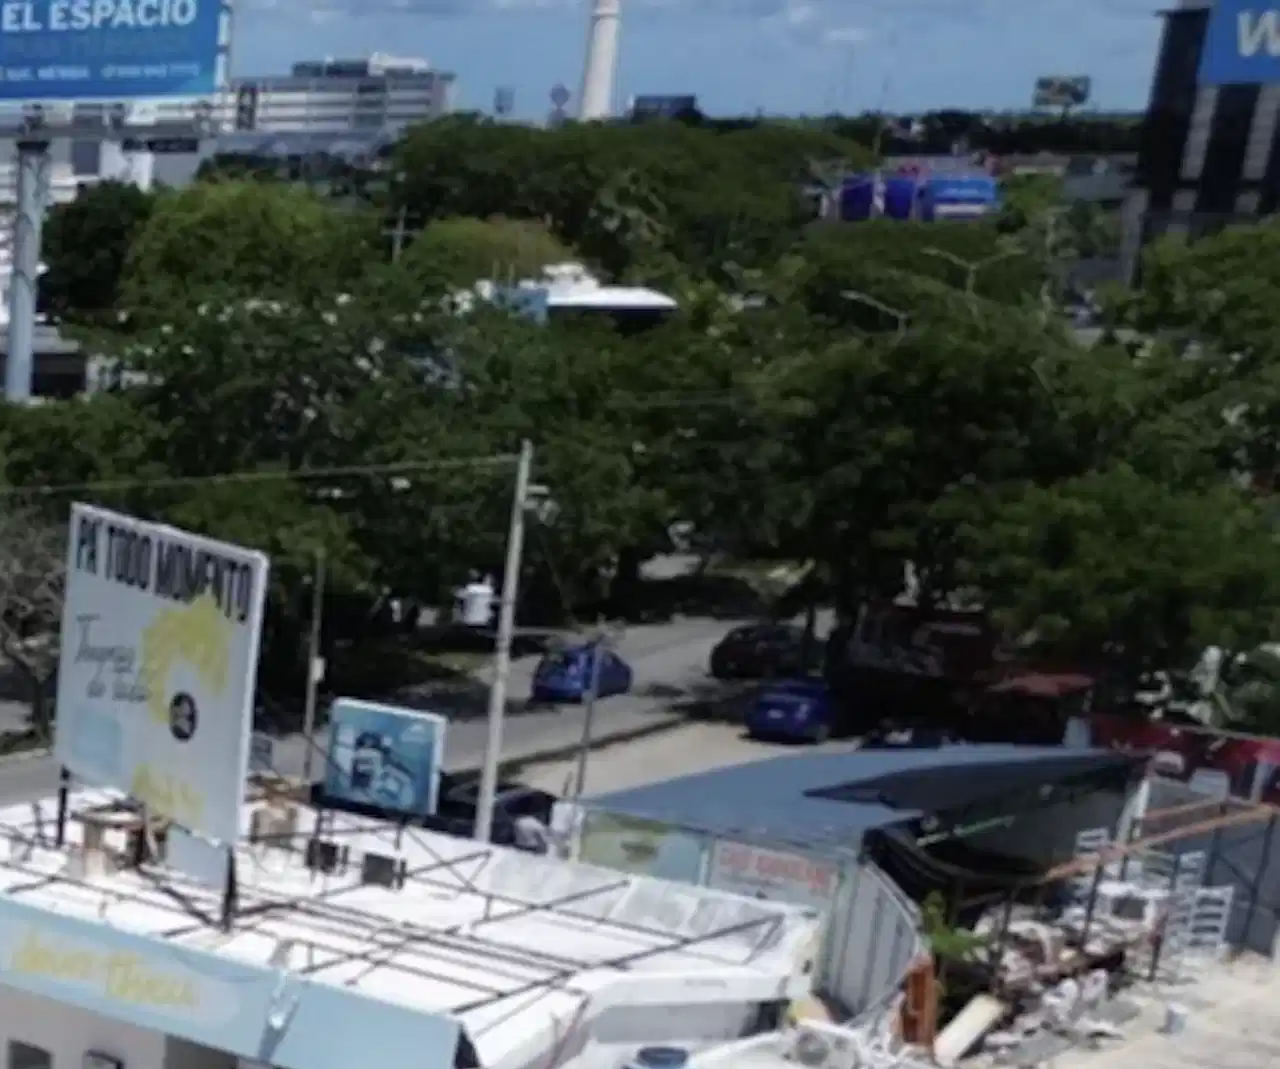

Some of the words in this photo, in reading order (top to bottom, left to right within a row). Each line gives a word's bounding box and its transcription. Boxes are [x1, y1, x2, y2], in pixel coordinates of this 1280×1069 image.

[1, 2, 42, 32] EL
[49, 0, 198, 30] ESPACIO
[105, 525, 151, 591] TODO
[154, 537, 252, 627] MOMENTO
